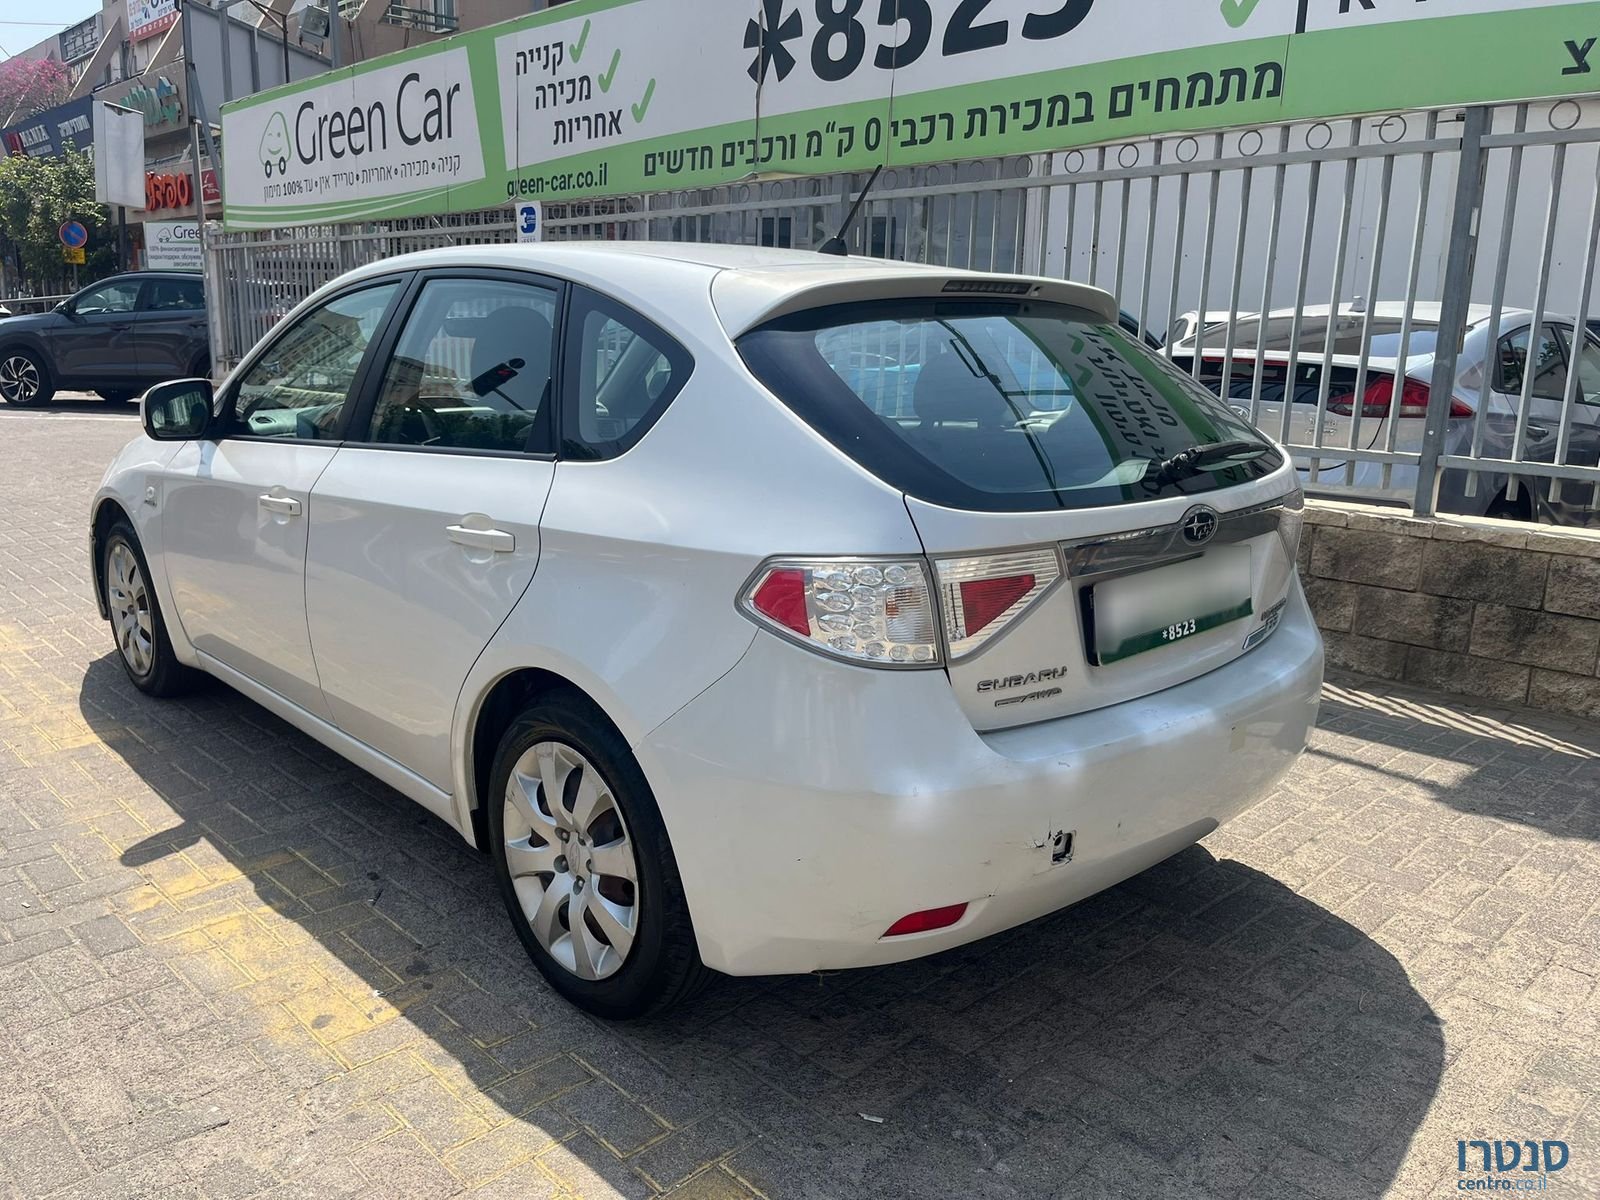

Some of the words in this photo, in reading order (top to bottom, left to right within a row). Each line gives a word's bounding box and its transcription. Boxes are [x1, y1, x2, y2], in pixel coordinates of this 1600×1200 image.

[516, 41, 564, 76] קנייה
[535, 75, 592, 110] מכירה
[1108, 61, 1284, 120] מתמחים
[295, 101, 387, 165] Green
[396, 72, 461, 146] Car
[553, 109, 623, 145] אחריות
[890, 112, 955, 148] רכבי
[963, 91, 1094, 140] במכירת
[721, 133, 797, 168] ורכבים
[863, 117, 882, 152] 0
[361, 164, 393, 184] אחריות
[400, 159, 430, 178] מכירה
[437, 154, 461, 176] קניה
[644, 145, 713, 177] חדשים
[283, 180, 304, 196] 100%
[303, 178, 314, 193] עד
[319, 175, 331, 195] אין
[332, 171, 355, 188] טרייד
[507, 162, 608, 199] green-car.co.il
[173, 225, 201, 239] Gree
[977, 665, 1068, 693] SUBARU
